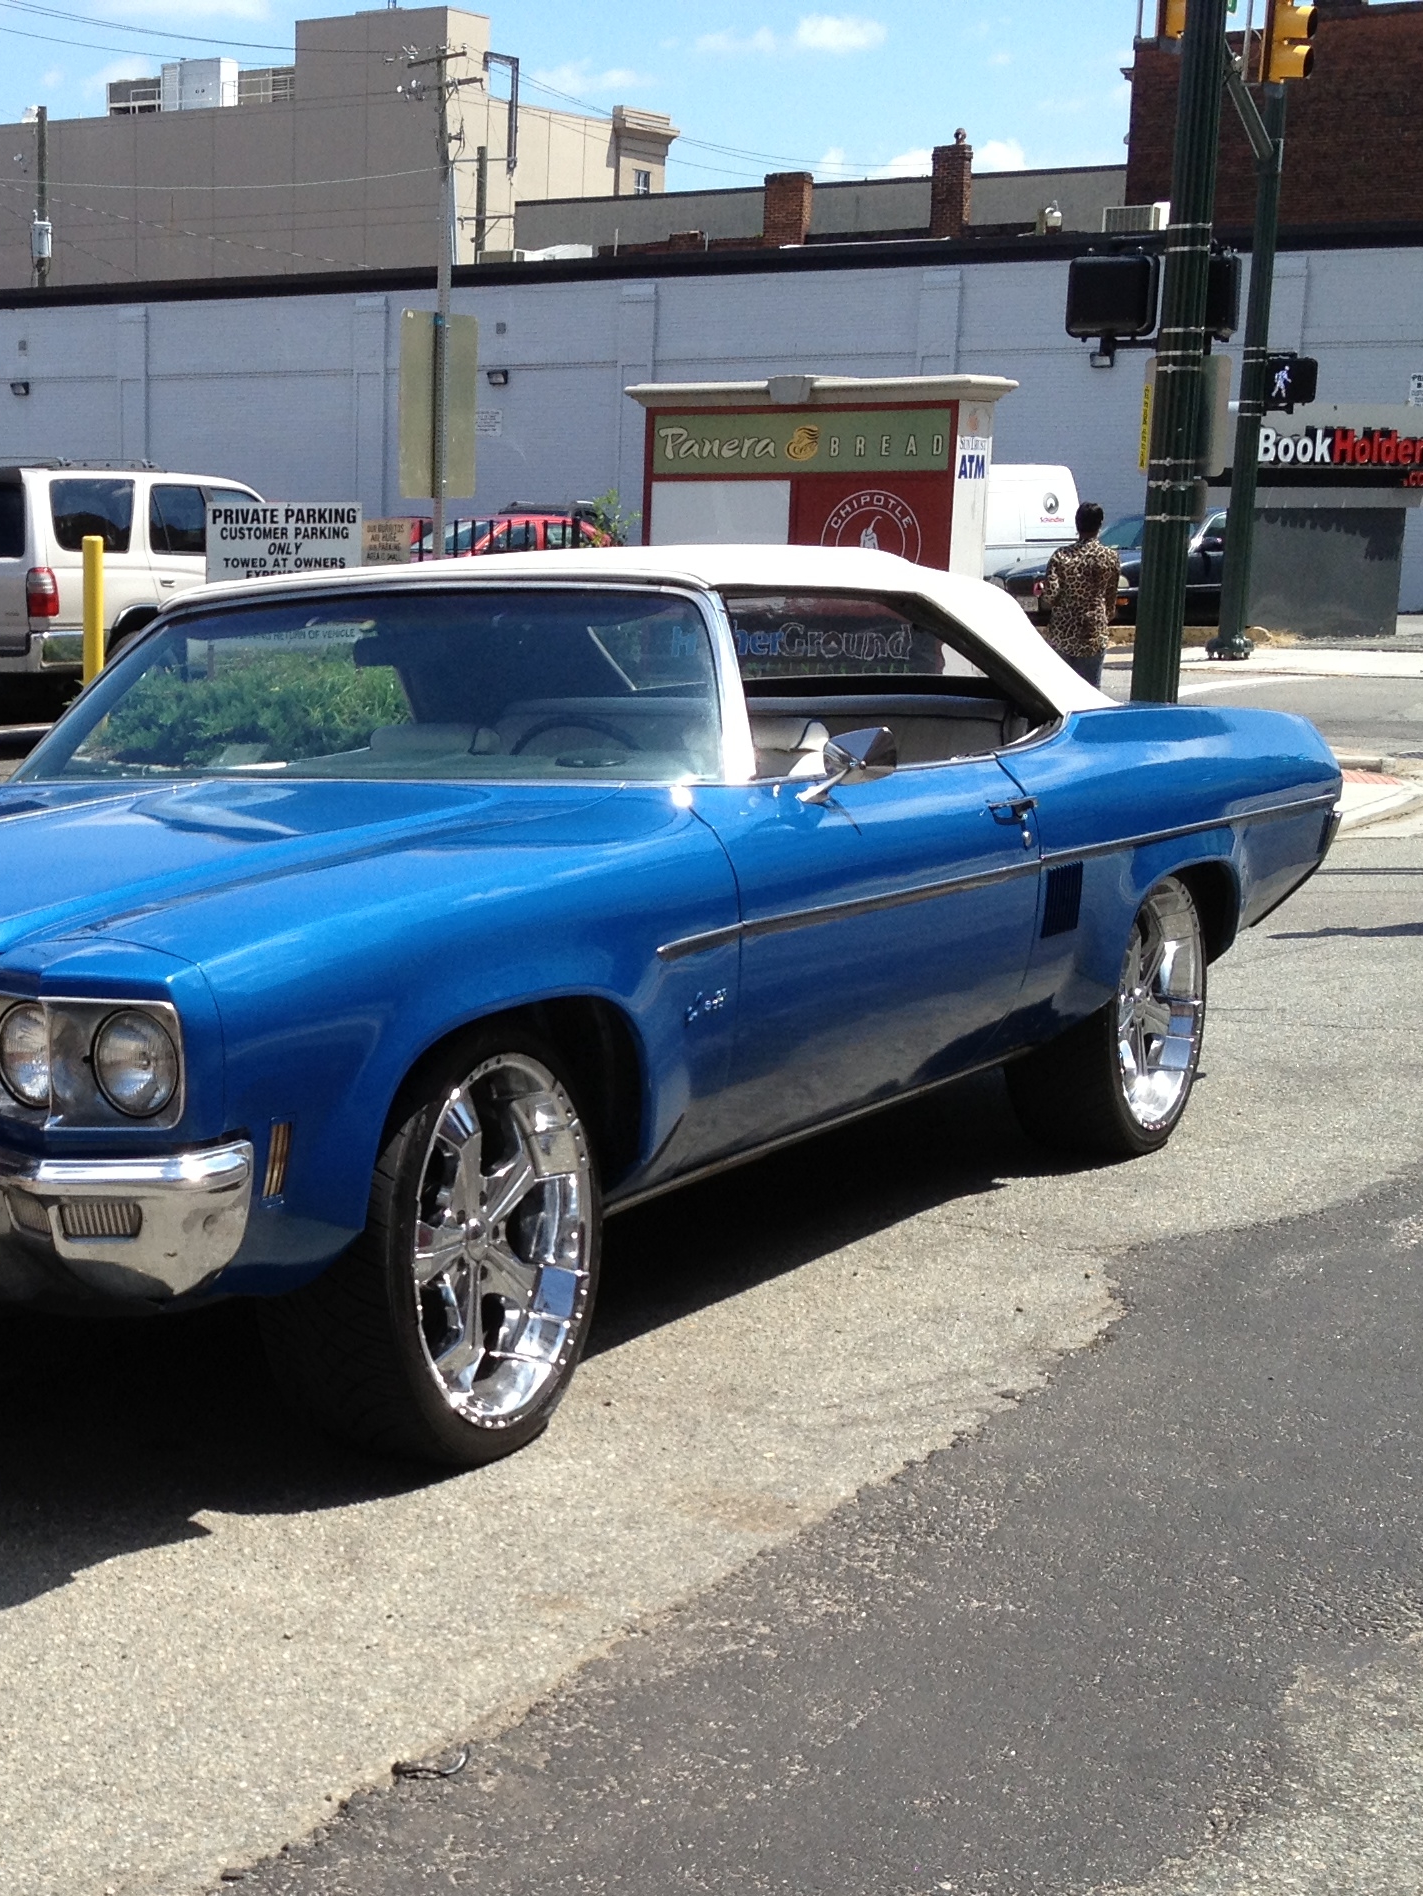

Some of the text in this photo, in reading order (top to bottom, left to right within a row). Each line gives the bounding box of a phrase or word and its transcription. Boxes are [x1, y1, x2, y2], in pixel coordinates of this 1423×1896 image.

[657, 424, 944, 460] Panera BREAD
[958, 454, 985, 479] ATM
[212, 508, 357, 525] PRIVATE PARKING
[830, 494, 914, 530] CHIPOTLE
[220, 526, 350, 541] CUSTOMER PARKING
[267, 542, 302, 556] ONLY
[223, 557, 346, 569] TOWED AT OWNERS
[322, 628, 356, 639] VEHICLE
